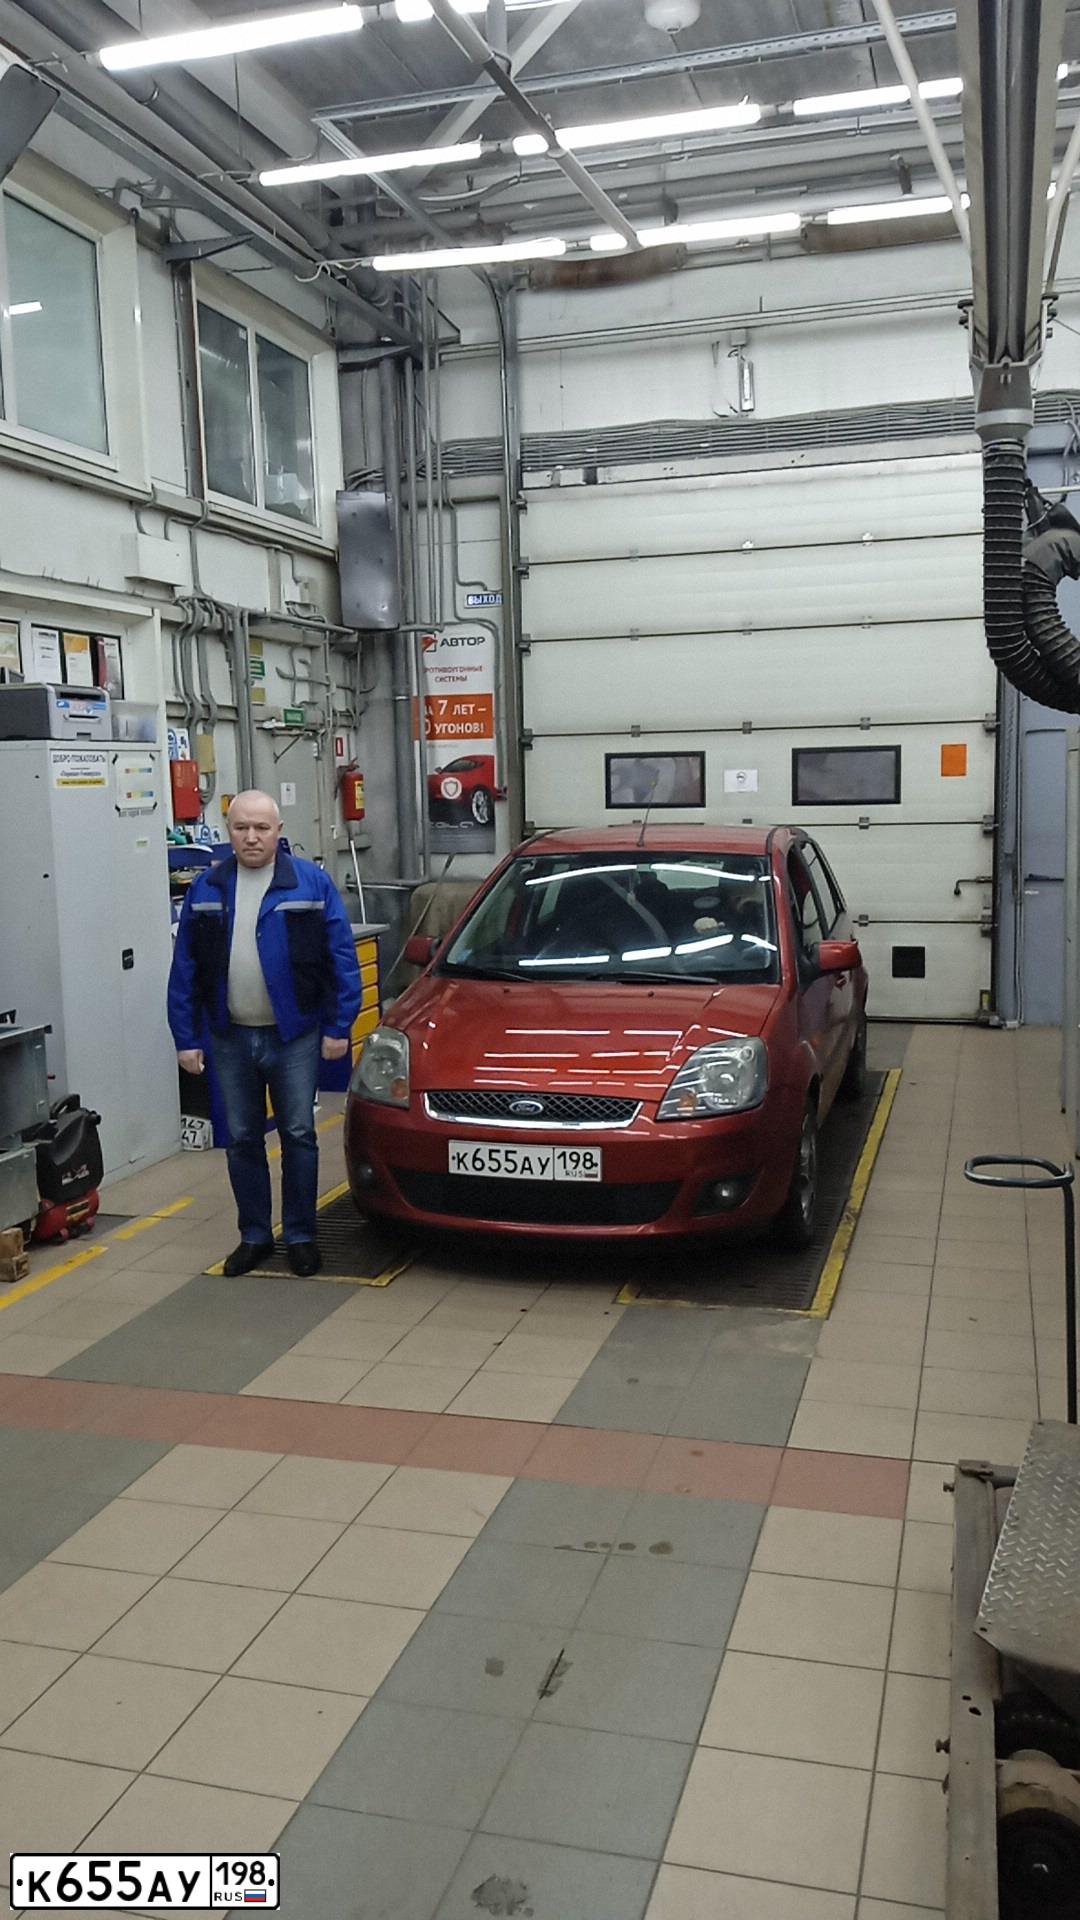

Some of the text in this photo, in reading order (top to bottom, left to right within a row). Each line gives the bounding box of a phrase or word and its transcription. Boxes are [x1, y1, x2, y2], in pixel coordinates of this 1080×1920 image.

[468, 594, 502, 605] ВЫХОД
[440, 636, 486, 647] АВТОР
[437, 699, 448, 716] 7
[452, 703, 476, 716] ЛЕТ
[434, 722, 485, 735] УГОНОВ!
[456, 1148, 594, 1175] К655АУ 198
